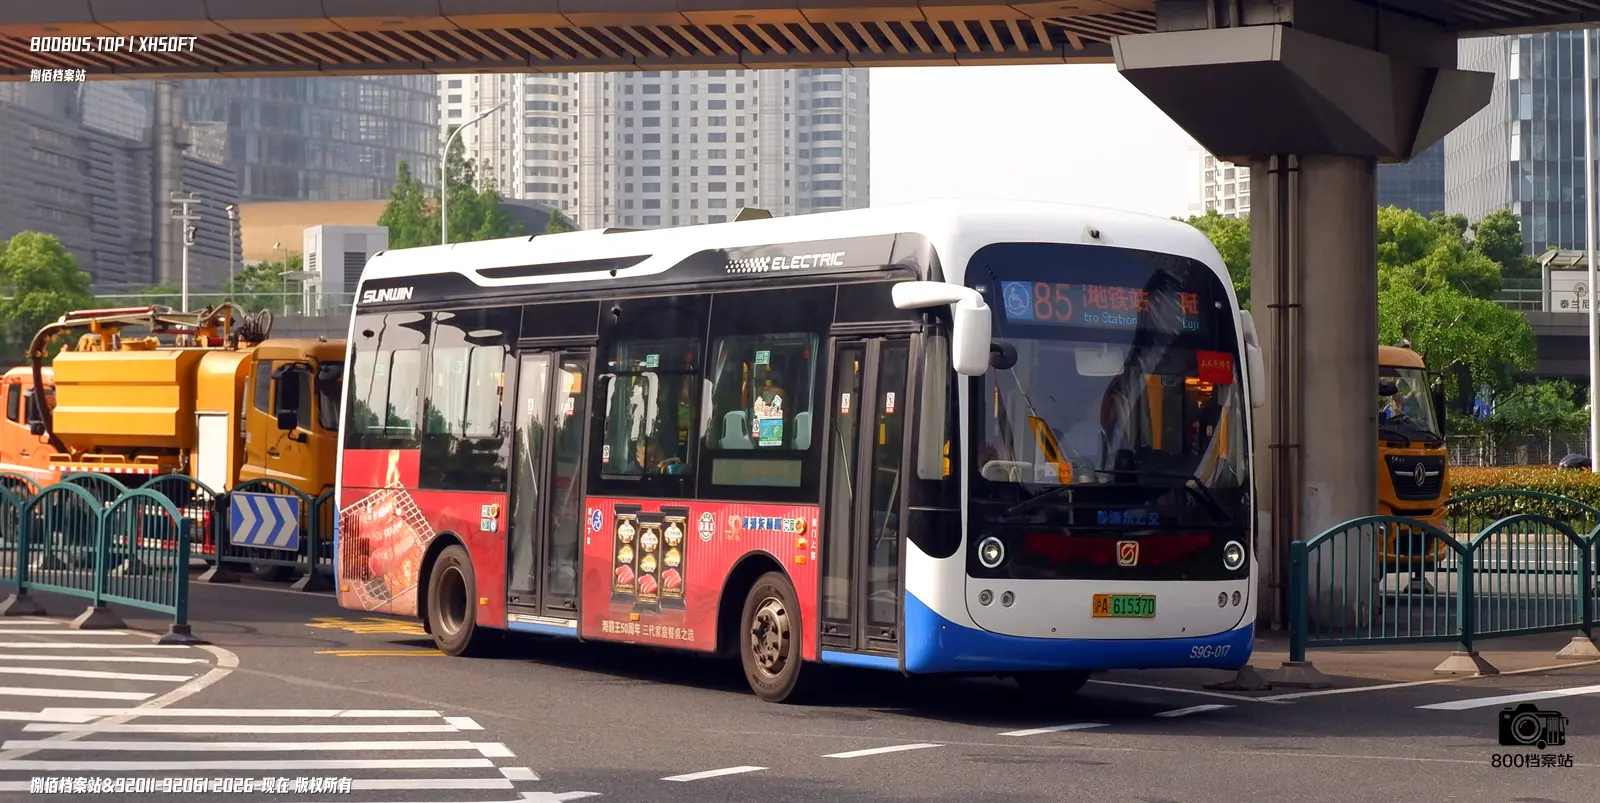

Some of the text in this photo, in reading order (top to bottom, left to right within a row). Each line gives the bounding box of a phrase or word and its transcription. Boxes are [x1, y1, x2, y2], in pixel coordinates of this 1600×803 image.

[771, 251, 846, 271] ELECTRIC
[362, 286, 414, 303] SUNWIN
[1034, 281, 1073, 321] 85
[1560, 298, 1600, 310] 泰兰尼
[1101, 311, 1138, 326] Station
[1189, 644, 1232, 660] S9G-017
